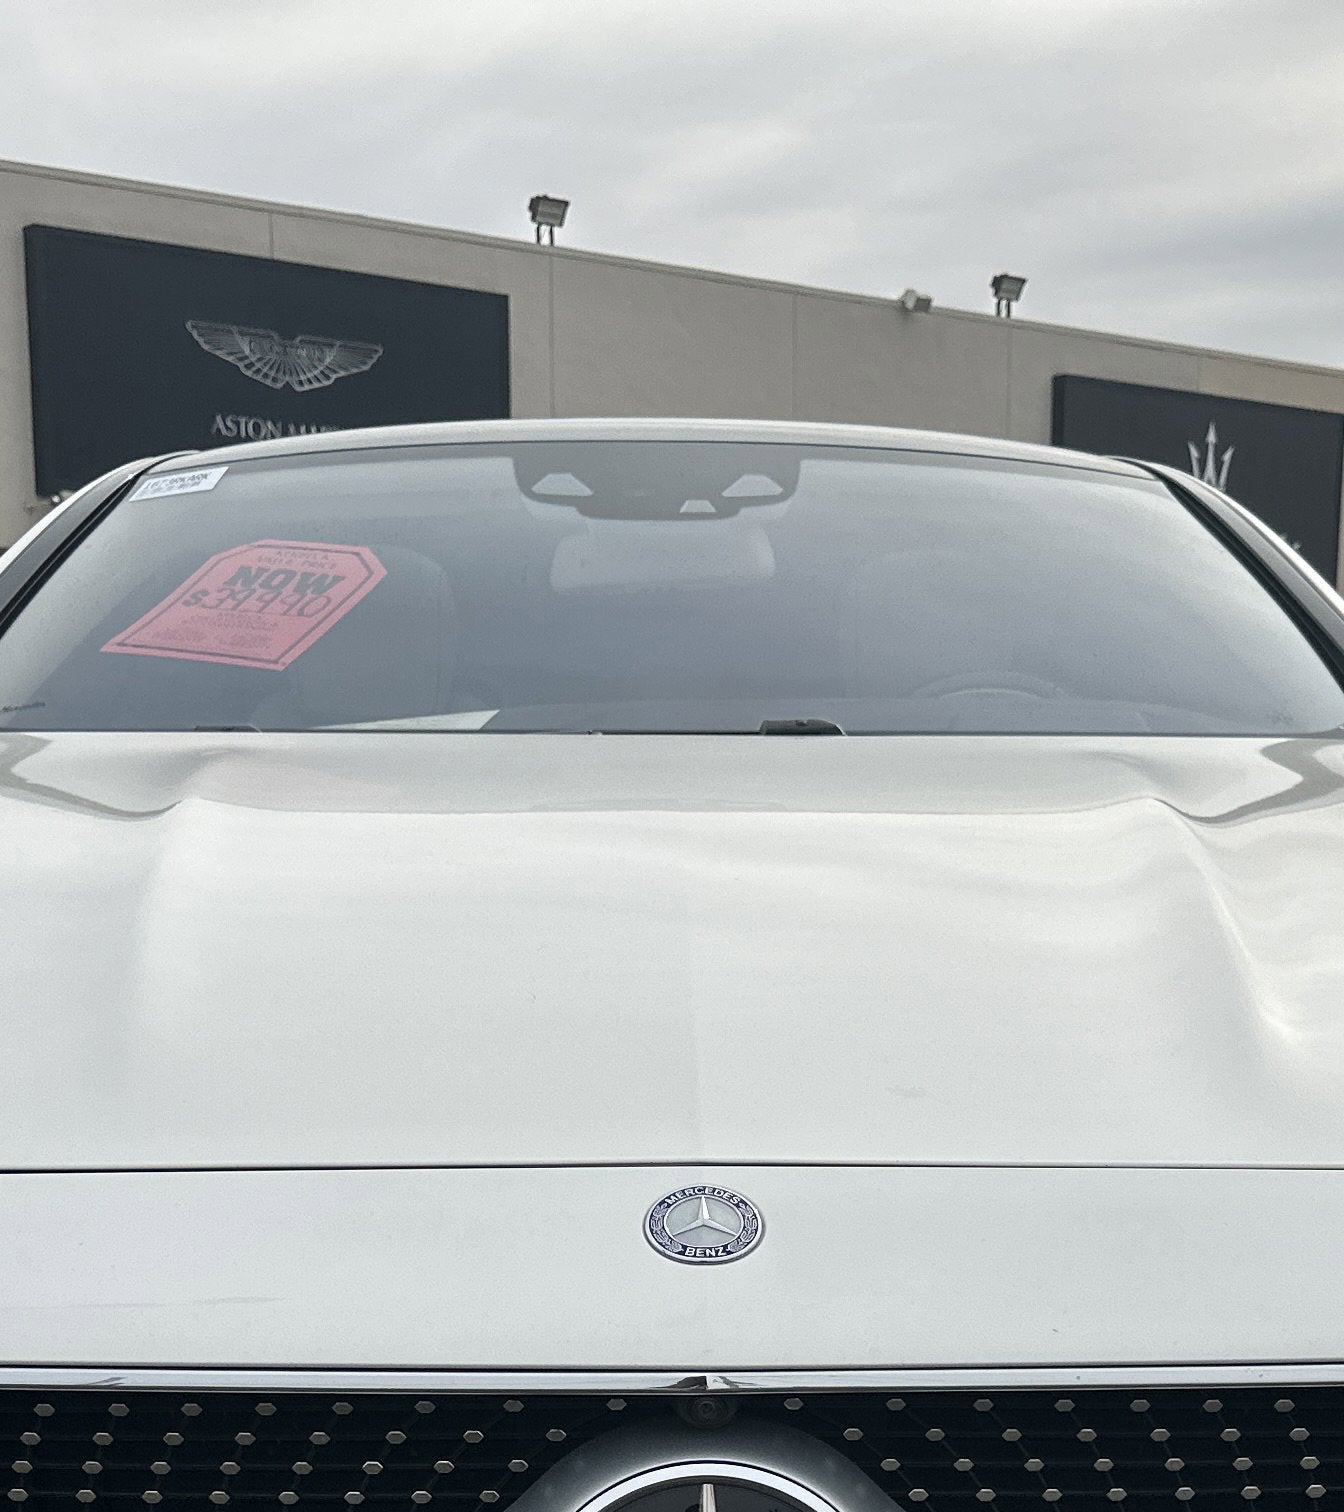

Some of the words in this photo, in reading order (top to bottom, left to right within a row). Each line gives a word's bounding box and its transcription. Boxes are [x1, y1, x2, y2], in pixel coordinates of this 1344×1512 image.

[211, 414, 283, 440] ASTON
[223, 565, 346, 596] NOW
[664, 1186, 741, 1205] MERCEDES
[684, 1246, 727, 1258] BENZ
